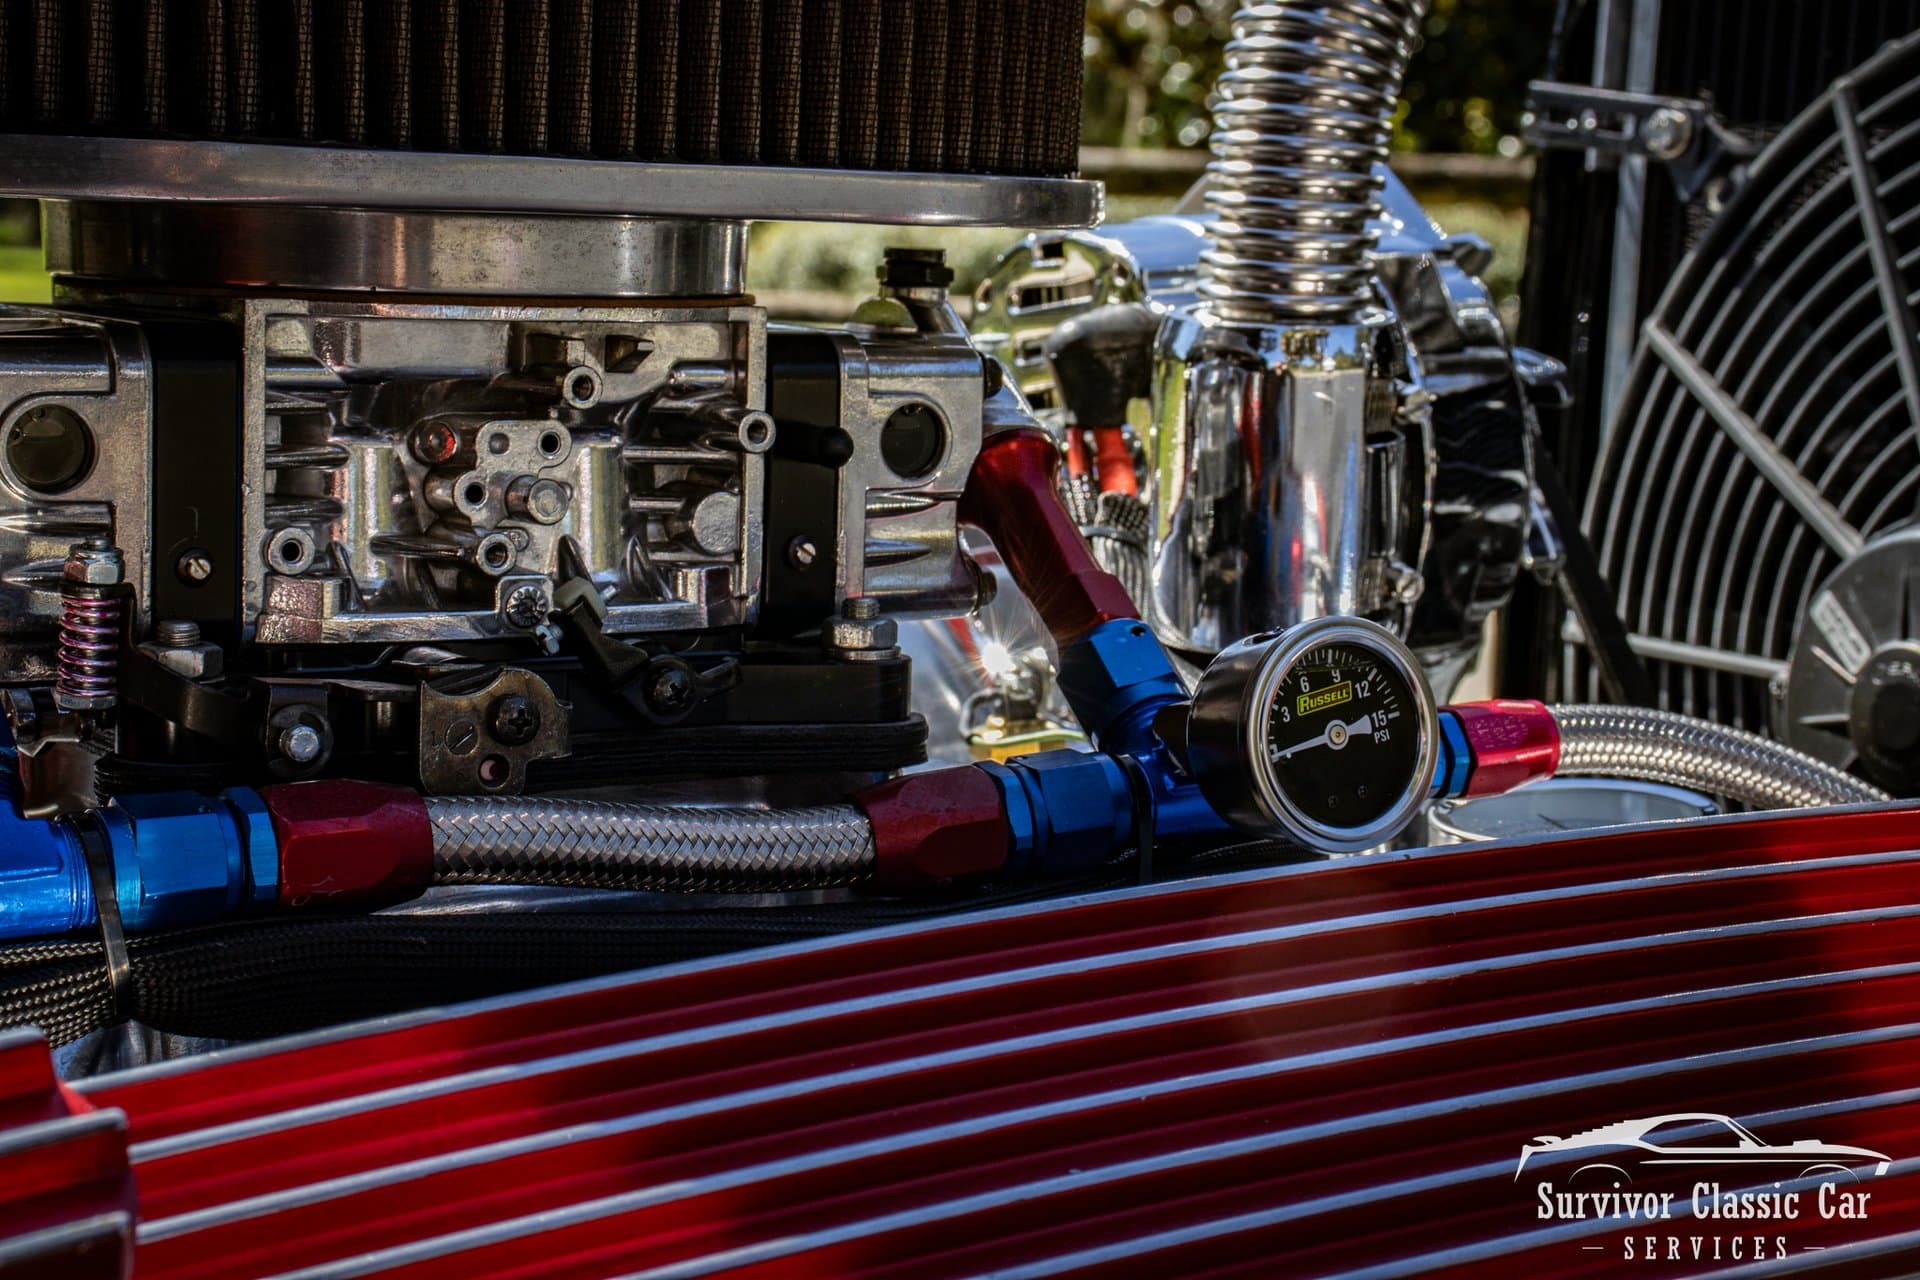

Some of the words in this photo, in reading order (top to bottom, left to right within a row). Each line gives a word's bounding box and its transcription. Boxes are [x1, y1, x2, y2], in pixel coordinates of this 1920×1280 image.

[1331, 668, 1341, 683] 9
[1300, 676, 1310, 693] 6
[1354, 680, 1371, 699] 12
[1300, 688, 1349, 713] RUSSELL
[1281, 706, 1290, 722] 3
[1371, 709, 1387, 728] 15
[1374, 728, 1391, 744] PSI
